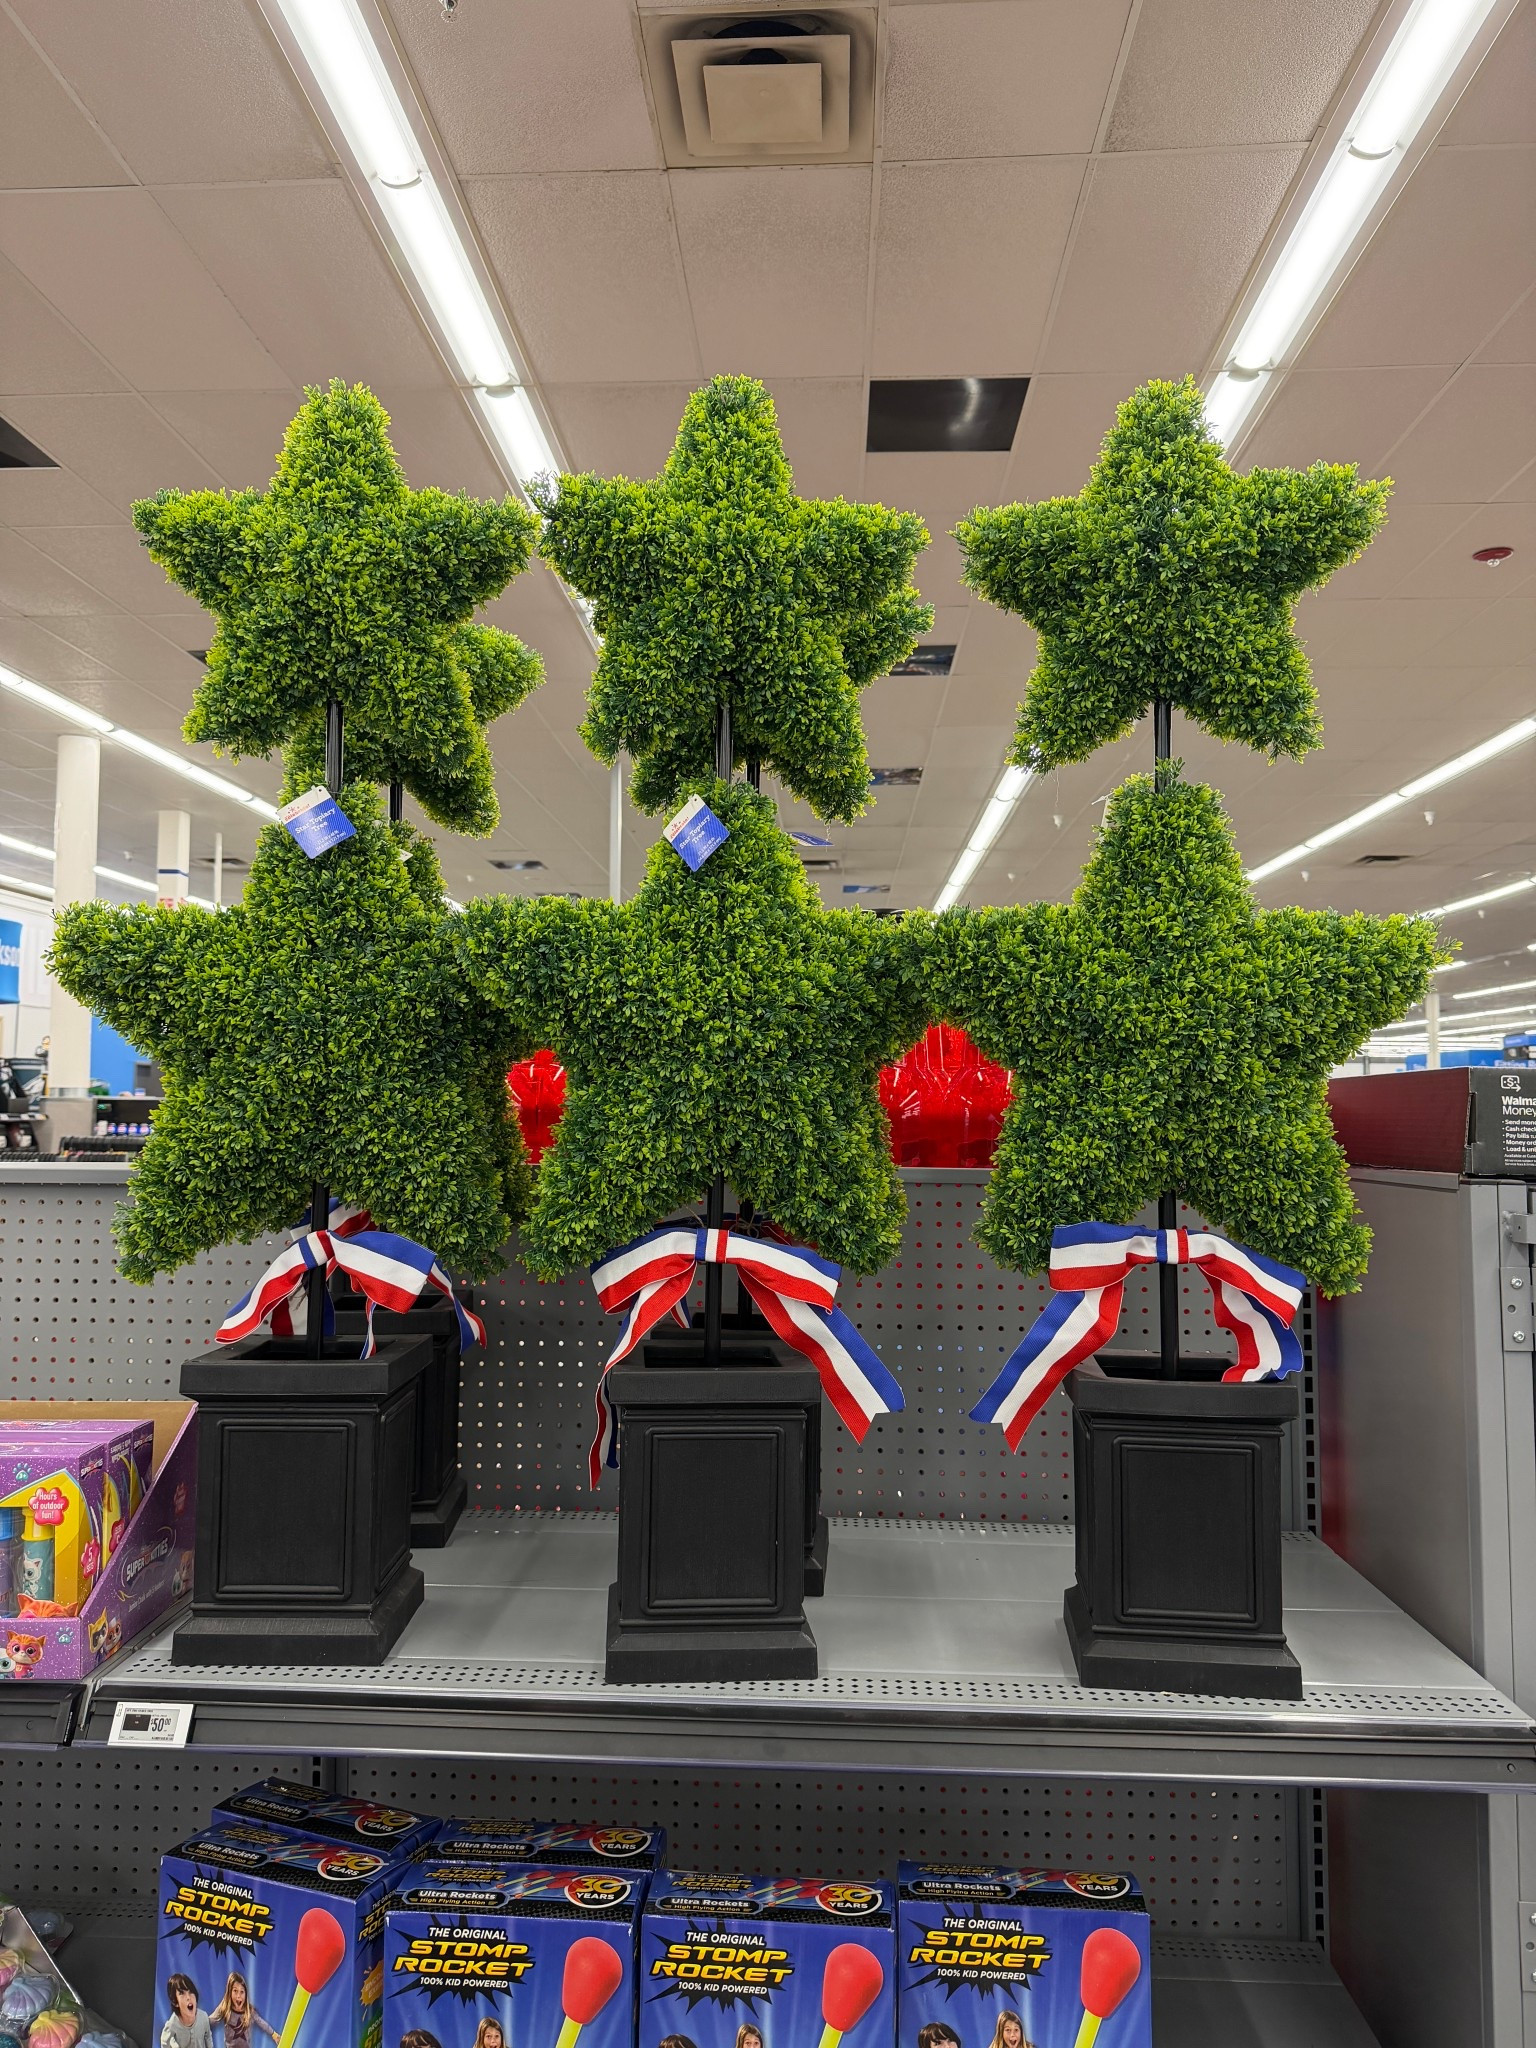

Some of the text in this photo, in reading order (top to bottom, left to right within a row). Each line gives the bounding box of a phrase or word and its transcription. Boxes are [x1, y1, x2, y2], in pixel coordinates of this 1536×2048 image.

[294, 808, 336, 834] Star Topiary
[311, 822, 328, 832] Tree
[680, 836, 690, 850] Star
[690, 815, 710, 836] Topiary
[692, 830, 705, 844] Tree
[1502, 1106, 1536, 1118] Money
[39, 1492, 58, 1500] Hours
[32, 1502, 64, 1510] of outdoor
[42, 1512, 54, 1520] fun!
[126, 1556, 144, 1582] SUPER
[270, 1802, 302, 1815] Rockets
[363, 1820, 394, 1832] YEARS
[198, 1842, 260, 1860] Ultra Rockets
[327, 1864, 359, 1876] YEARS
[193, 1877, 253, 1899] THE ORIGINAL
[672, 1881, 754, 1889] ROCKET
[955, 1883, 1001, 1891] Rockets
[1079, 1884, 1118, 1892] YEARS
[418, 1890, 496, 1900] Ultra Rockets
[576, 1892, 614, 1900] YEARS
[178, 1887, 270, 1917] STOMP
[438, 1898, 461, 1906] Flying
[165, 1900, 273, 1936] ROCKET
[944, 1918, 1022, 1931] THE ORIGINAL
[184, 1923, 253, 1946] 100% KID POWERED
[429, 1928, 506, 1940] THE ORIGINAL
[686, 1932, 765, 1946] THE ORIGINAL
[926, 1931, 1044, 1950] STOMP
[410, 1940, 528, 1958] STOMP
[667, 1944, 787, 1964] STOMP
[910, 1948, 1050, 1968] ROCKET
[394, 1958, 533, 1976] ROCKET
[652, 1961, 792, 1982] ROCKET
[937, 1968, 1025, 1980] 100% KID POWERED
[420, 1976, 508, 1988] 100% KID POWERED
[678, 1982, 767, 1994] 100% KID POWERED
